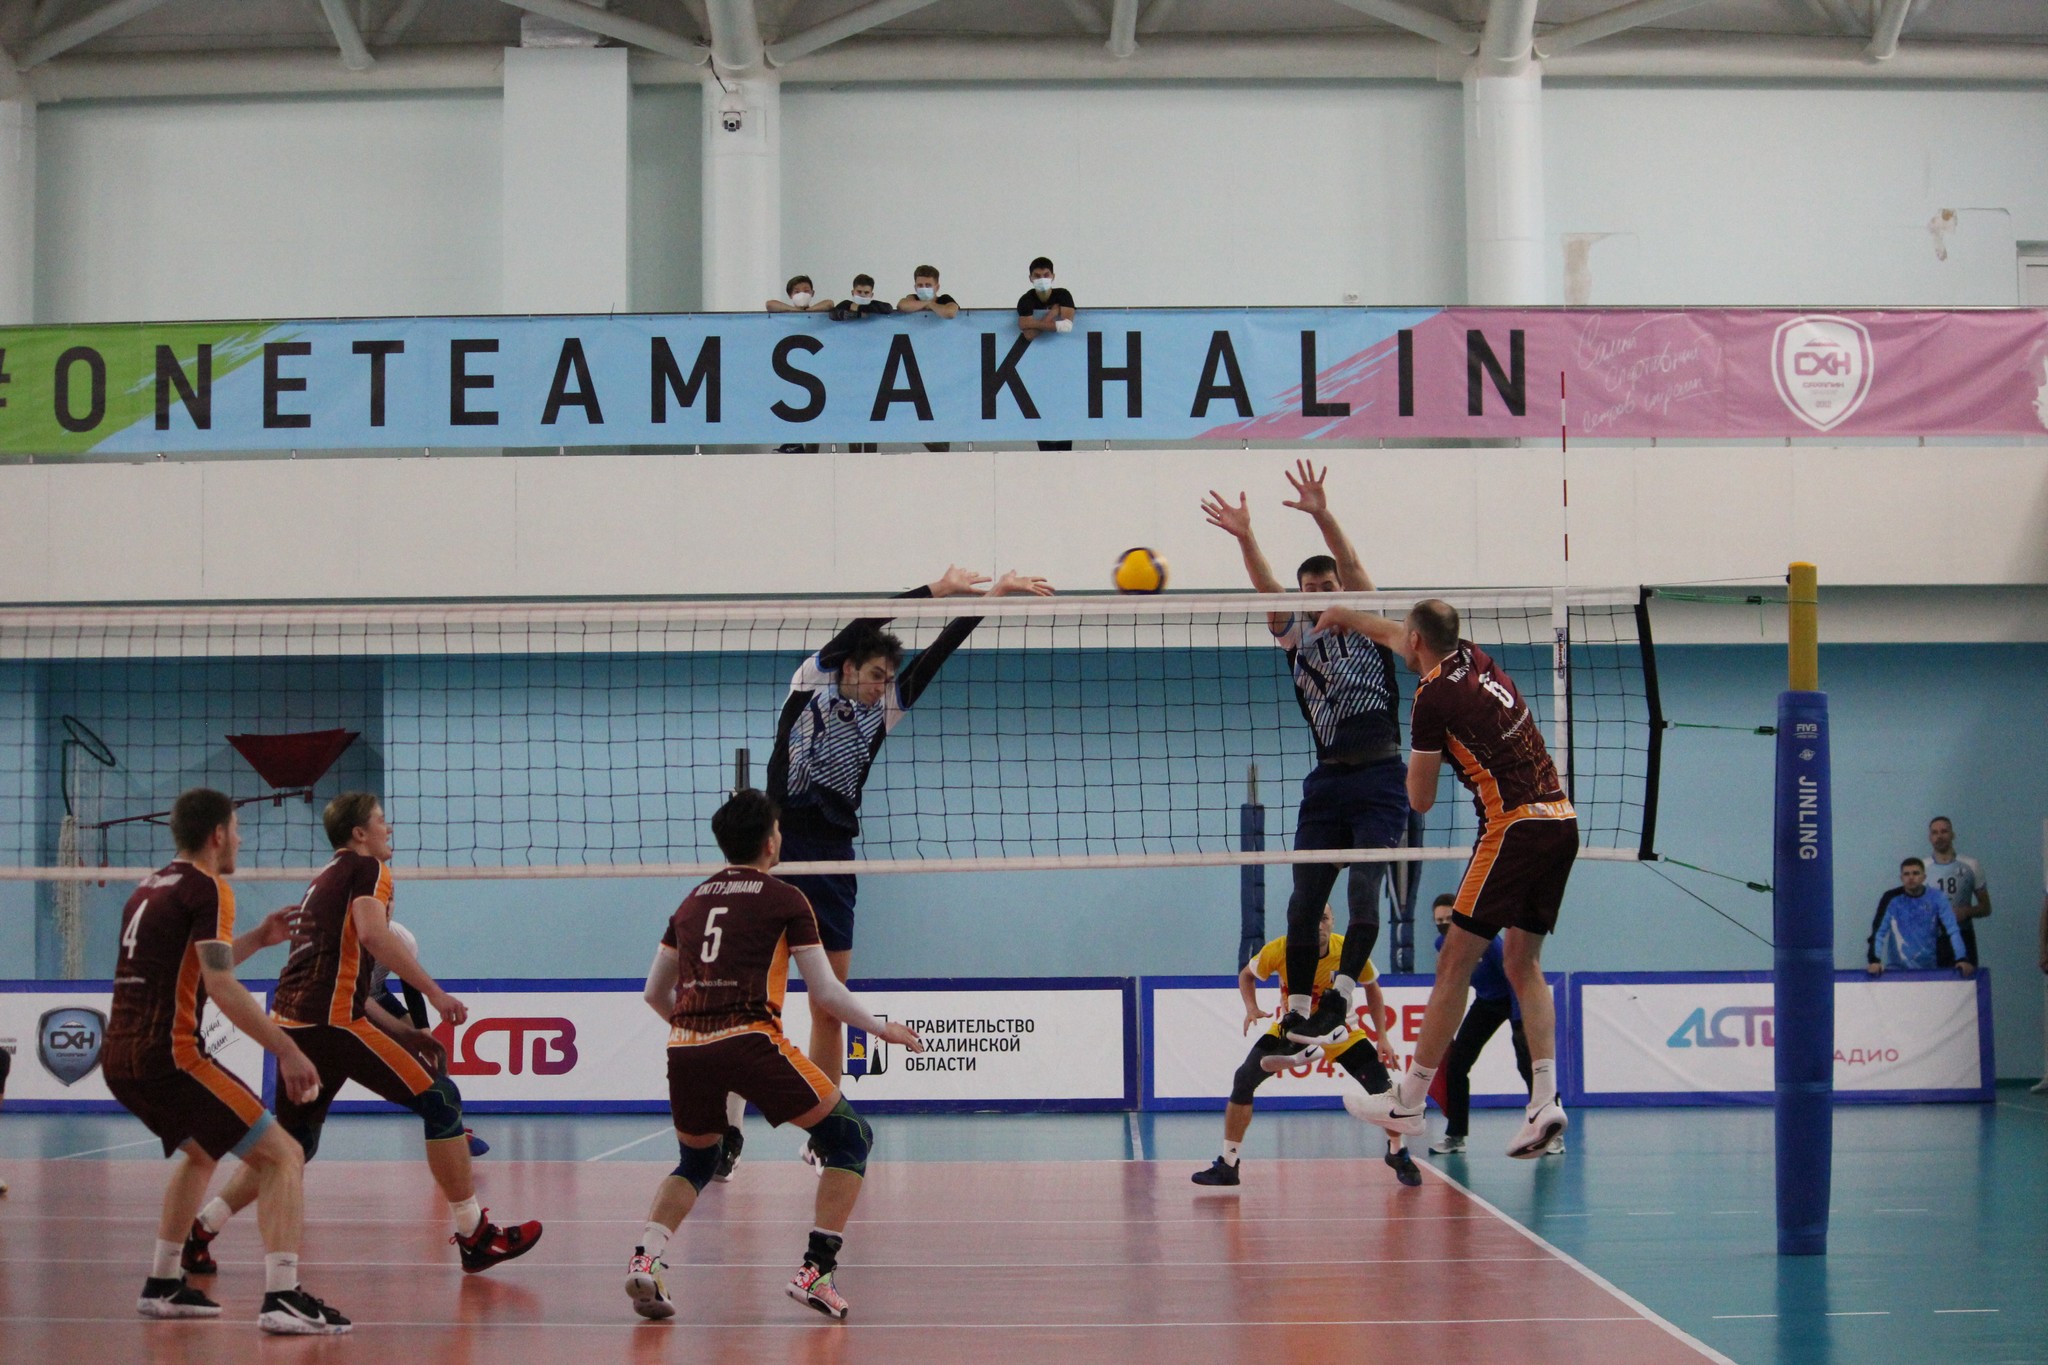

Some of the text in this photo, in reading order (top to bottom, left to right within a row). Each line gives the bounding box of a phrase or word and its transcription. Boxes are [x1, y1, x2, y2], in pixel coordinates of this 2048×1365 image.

[1796, 723, 1818, 732] FIVB
[1798, 775, 1818, 860] JINLING
[1936, 876, 1958, 894] 18
[121, 899, 149, 960] 4
[700, 907, 729, 963] 5
[905, 1056, 976, 1072] ОБЛАСТИ
[1832, 1048, 1899, 1066] АДИО
